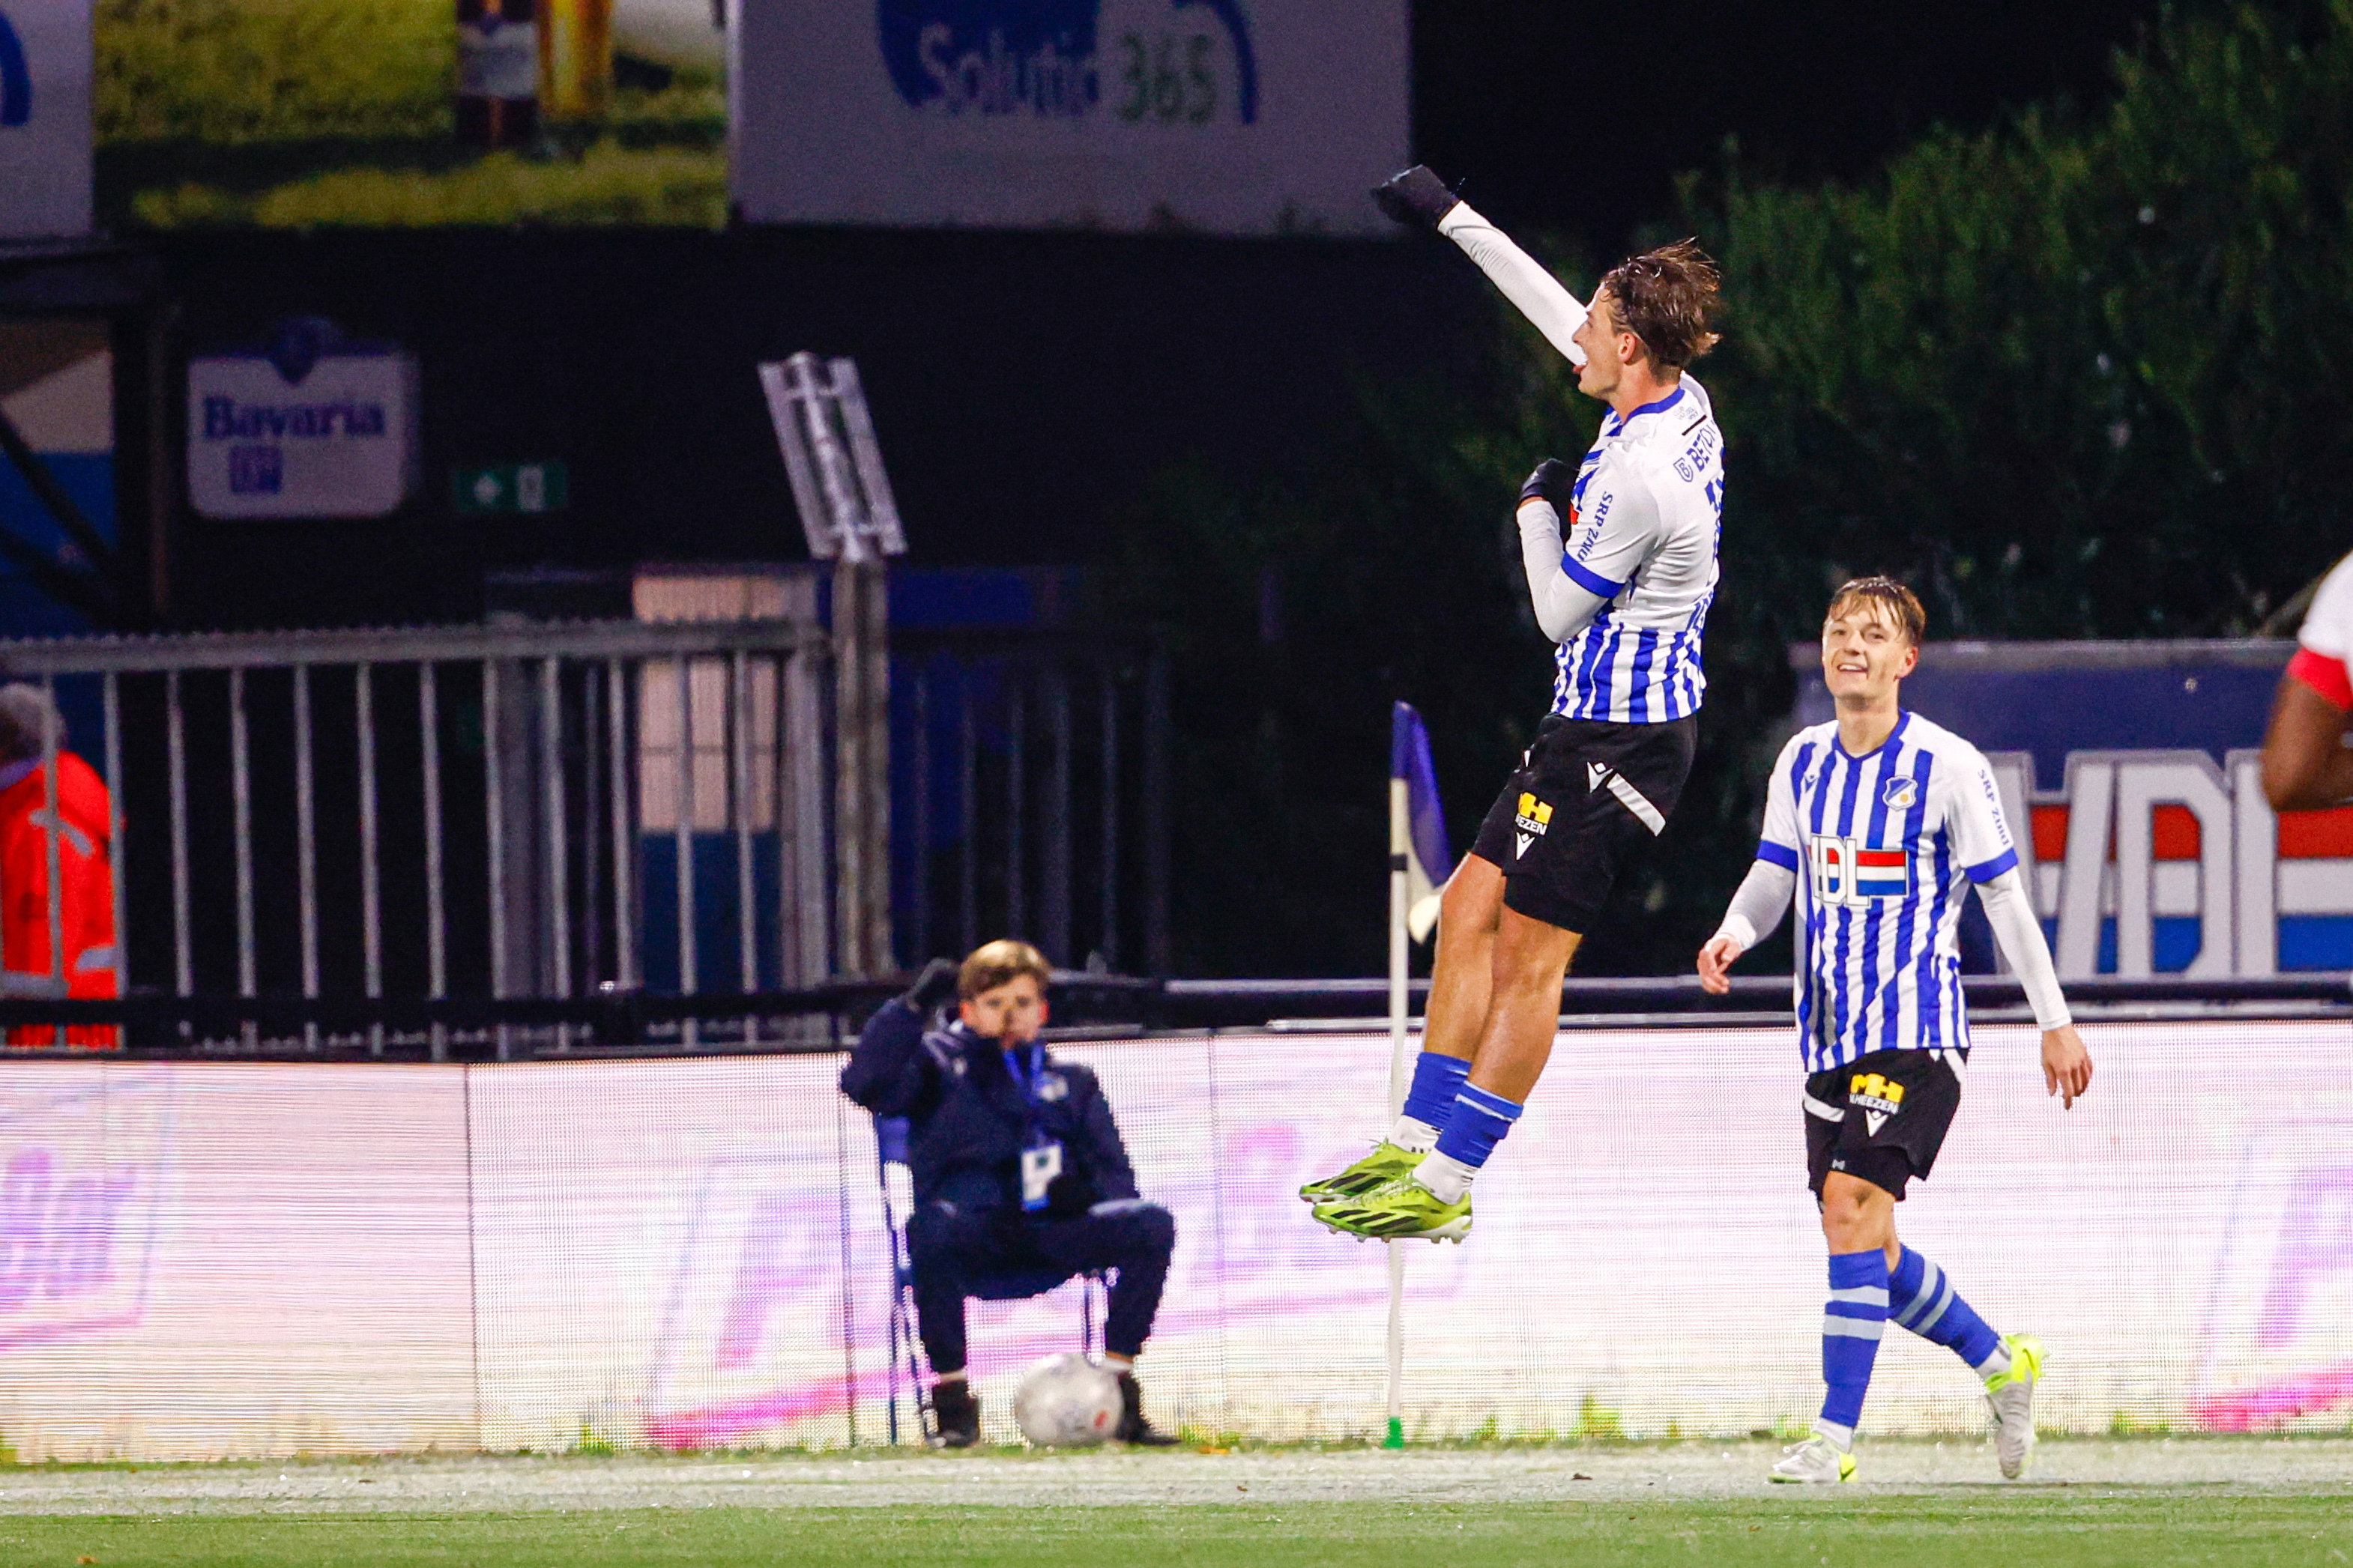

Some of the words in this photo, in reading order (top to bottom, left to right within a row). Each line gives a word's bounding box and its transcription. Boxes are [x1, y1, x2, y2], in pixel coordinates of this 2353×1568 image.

[1117, 32, 1218, 124] 365
[202, 396, 386, 441] Bavaria
[1594, 491, 1613, 527] SRP
